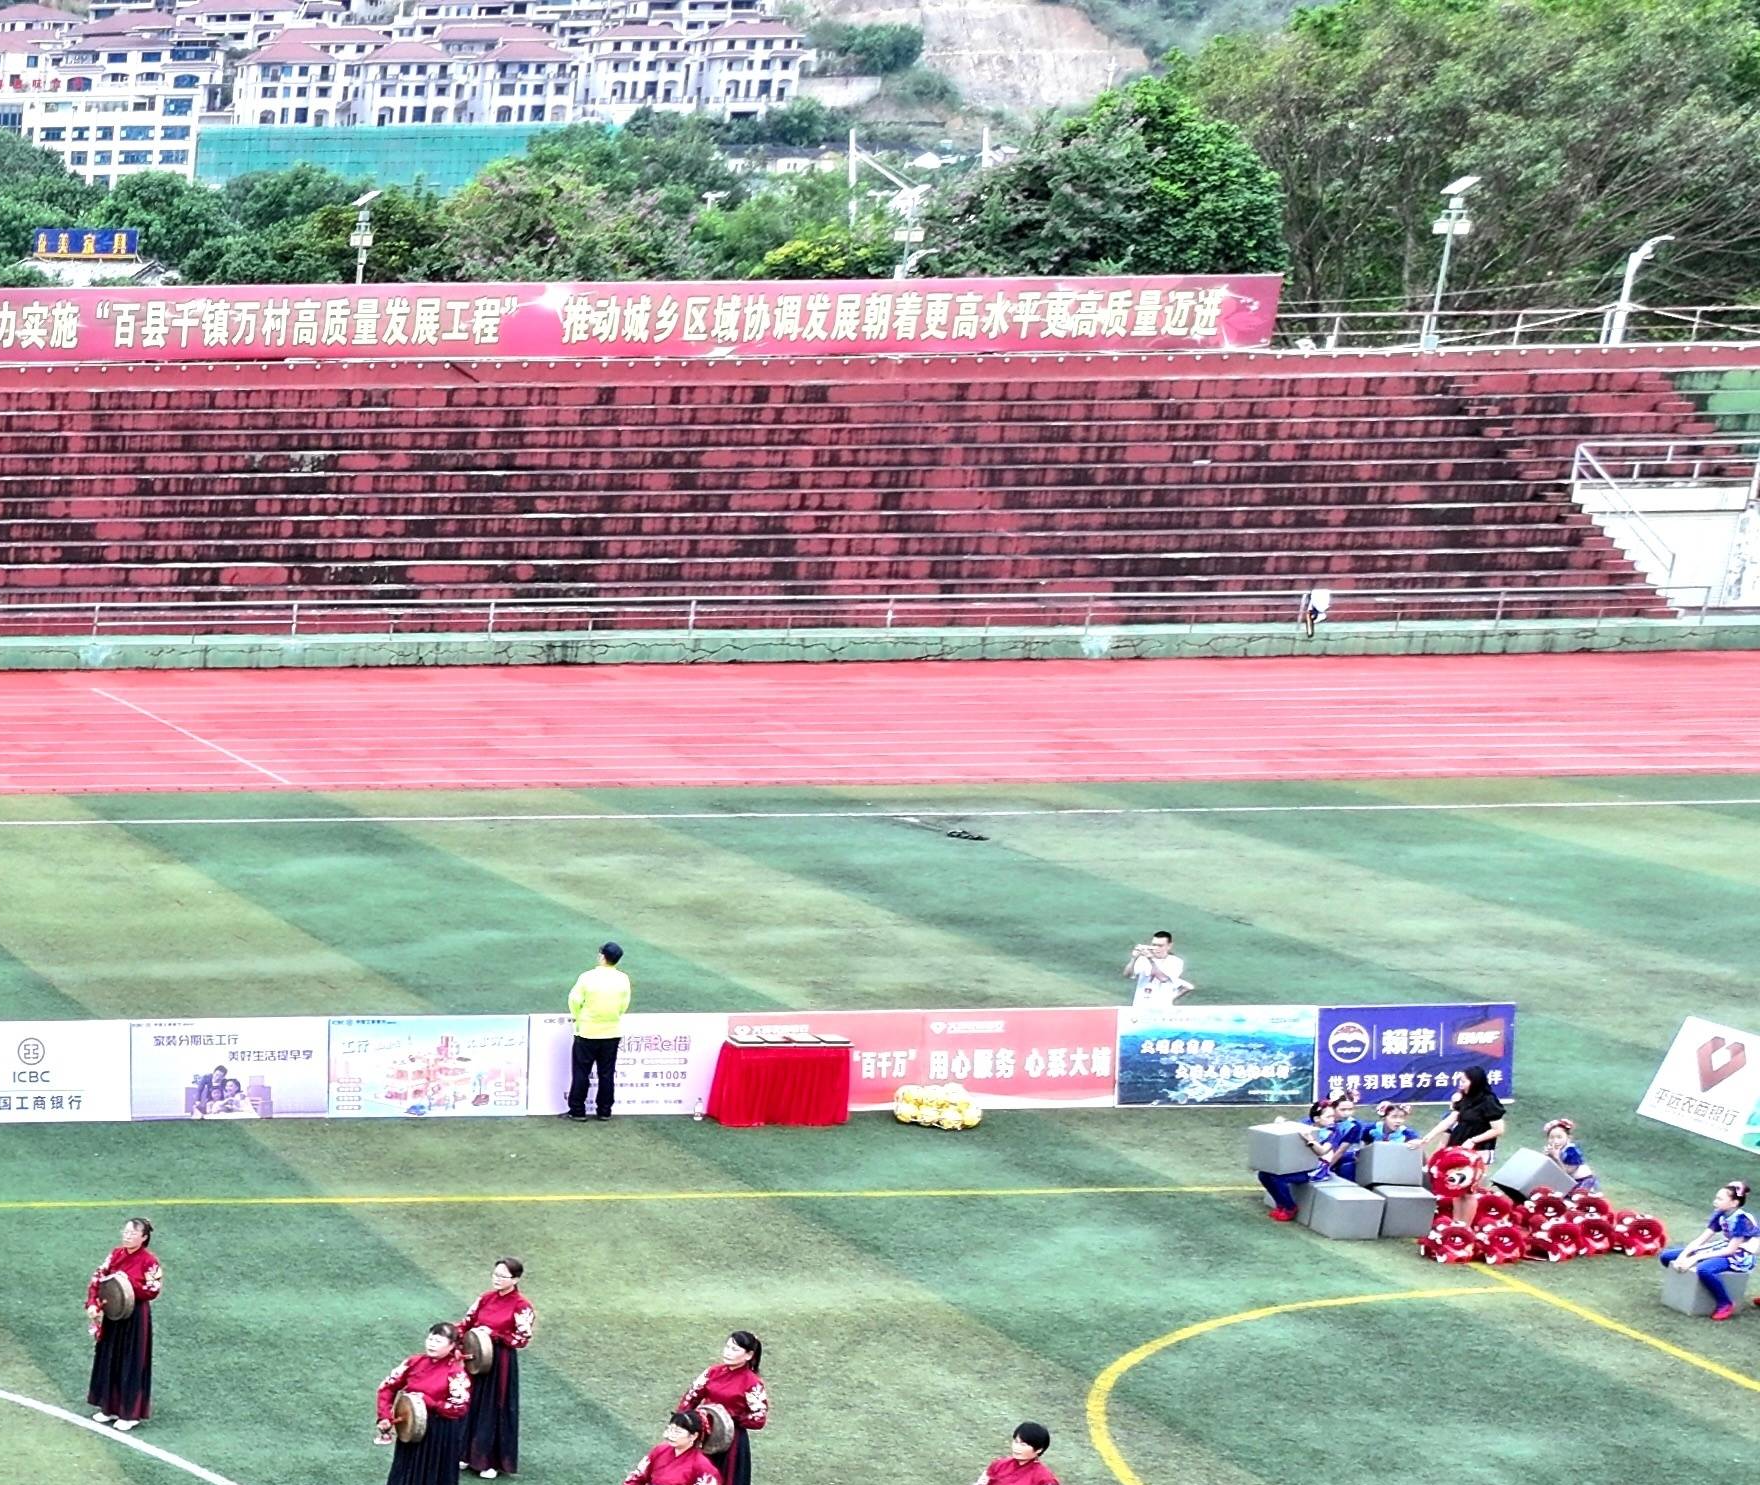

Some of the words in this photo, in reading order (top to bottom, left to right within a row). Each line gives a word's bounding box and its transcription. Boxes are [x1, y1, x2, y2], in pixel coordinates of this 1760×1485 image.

[153, 1034, 239, 1047] 家装分期选工行
[228, 1050, 313, 1062] 美好生活提早享
[929, 1048, 1017, 1080] 用心服务
[1025, 1047, 1112, 1078] 心系大埔
[12, 1071, 51, 1083] ICBC
[1327, 1070, 1504, 1091] 世界羽联官方合作伴
